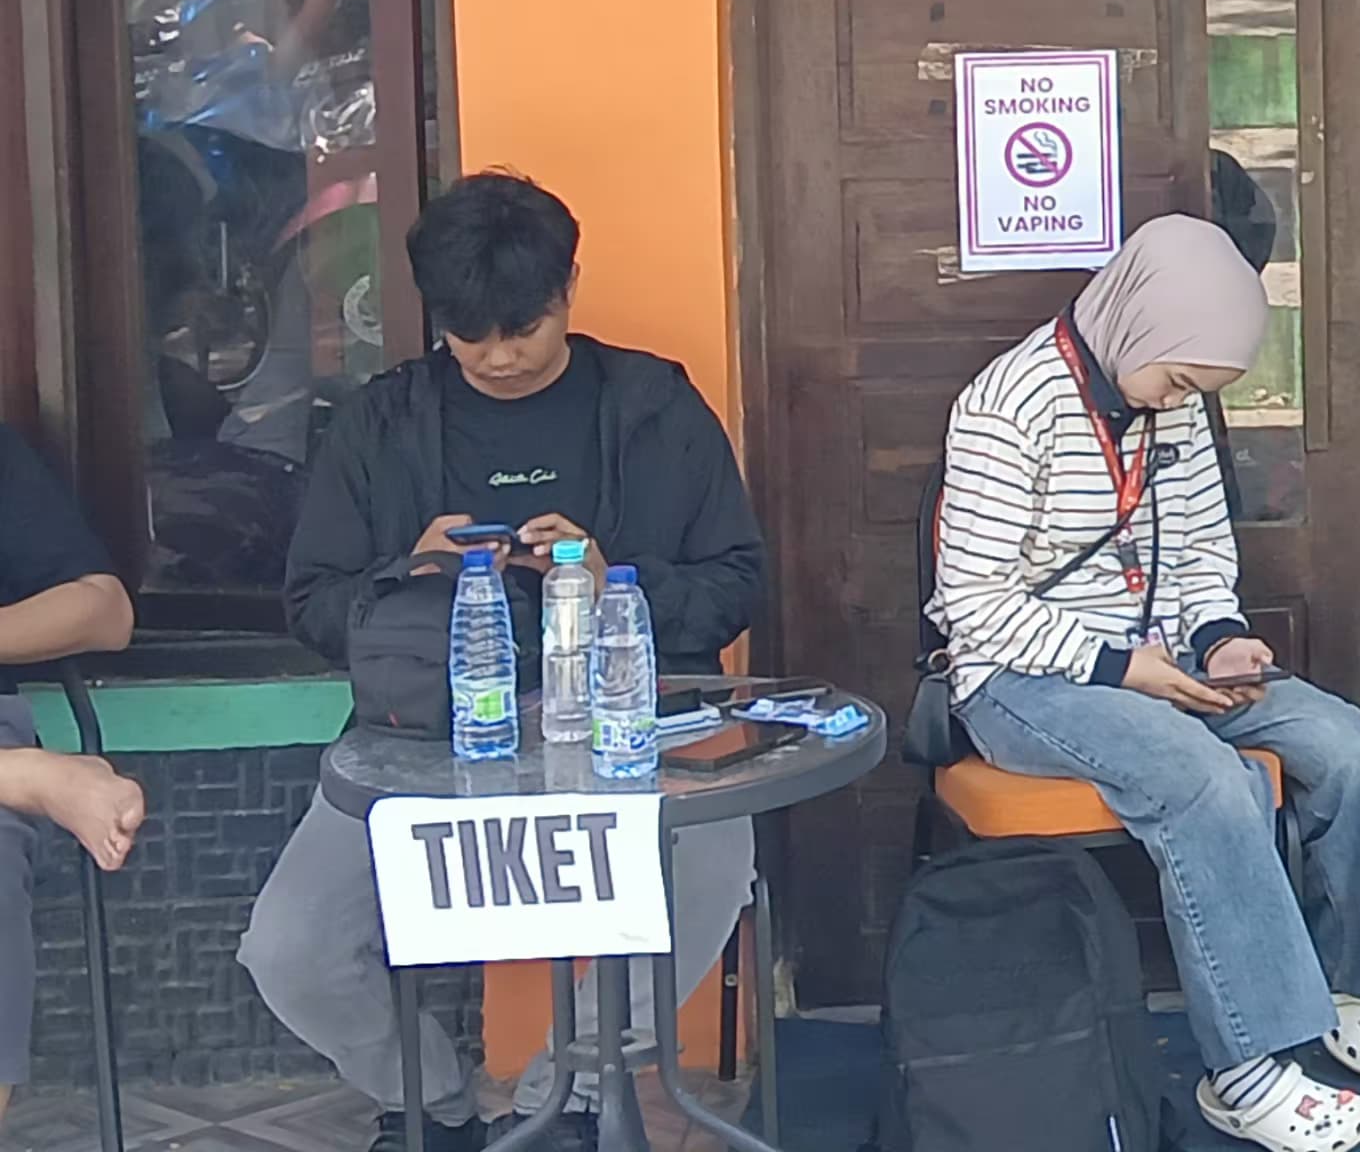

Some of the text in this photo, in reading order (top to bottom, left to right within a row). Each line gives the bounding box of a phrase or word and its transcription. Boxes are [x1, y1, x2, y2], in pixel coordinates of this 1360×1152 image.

[1020, 76, 1054, 94] NO
[984, 96, 1091, 115] SMOKING
[1023, 195, 1057, 212] NO
[998, 214, 1084, 233] VAPING
[411, 811, 618, 911] TIKET
